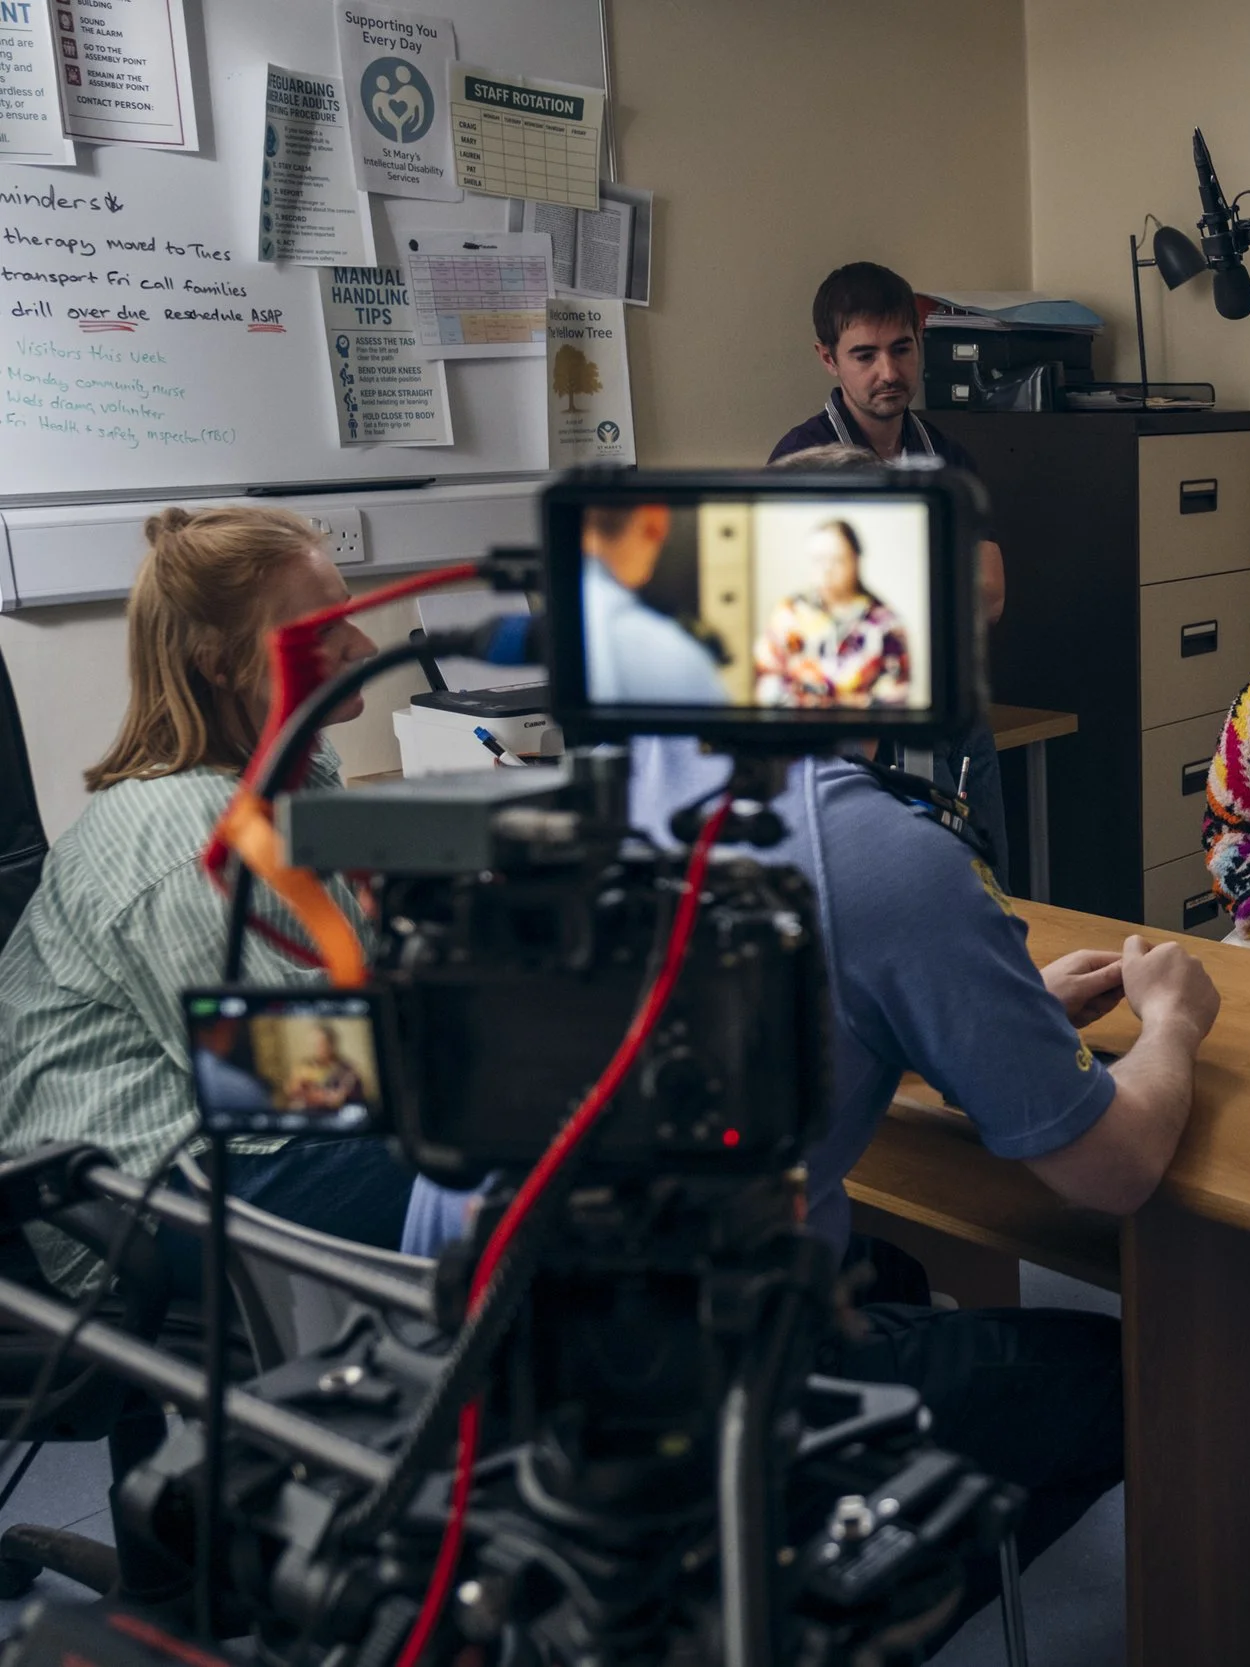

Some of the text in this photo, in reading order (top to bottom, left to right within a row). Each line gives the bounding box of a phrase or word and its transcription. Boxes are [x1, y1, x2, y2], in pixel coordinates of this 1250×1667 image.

[0, 2, 31, 24] NT
[80, 17, 105, 26] SOUND
[345, 11, 437, 38] Supporting You
[81, 26, 94, 34] THE
[18, 40, 34, 48] are
[363, 32, 422, 54] Every Day
[85, 53, 120, 63] ASSEMBLY
[14, 64, 33, 73] and
[87, 70, 114, 79] REMAIN
[89, 80, 150, 92] ASSEMBLY POINT
[269, 72, 334, 98] FEGUARDING
[35, 89, 45, 97] of
[474, 84, 574, 114] STAFF ROTATION
[77, 96, 154, 111] CONTACT PERSON:
[269, 90, 340, 111] ERABLE ADULTS
[6, 112, 39, 121] ensure
[290, 108, 336, 122] PROCEDURE
[459, 121, 476, 130] CRAIG
[461, 136, 476, 145] MARY
[383, 148, 421, 162] St Mary's
[460, 151, 481, 160] LAUREN
[364, 157, 444, 177] Intellectual Disability
[466, 165, 476, 173] PAT
[387, 172, 420, 184] Services
[464, 178, 482, 187] SHEILA
[4, 227, 96, 256] therapy
[166, 241, 185, 255] to
[187, 243, 231, 261] Tues
[1, 266, 247, 297] transport Fri call families
[334, 267, 405, 286] MANUAL
[11, 300, 53, 317] drill
[251, 309, 283, 324] ASAP
[355, 307, 392, 325] TIPS
[588, 310, 601, 321] to
[586, 327, 613, 338] Tree
[356, 337, 415, 346] ASSESS THE TAS
[16, 334, 81, 360] Visitors
[88, 344, 122, 363] this
[7, 366, 186, 400] Monday community nurse
[6, 390, 43, 407] Weds
[100, 400, 165, 420] volunteer
[363, 412, 379, 420] HOLD
[6, 412, 26, 427] Fri
[38, 415, 79, 433] Health
[98, 426, 139, 449] safety
[200, 428, 236, 445] (TBC)
[523, 719, 546, 729] Canon
